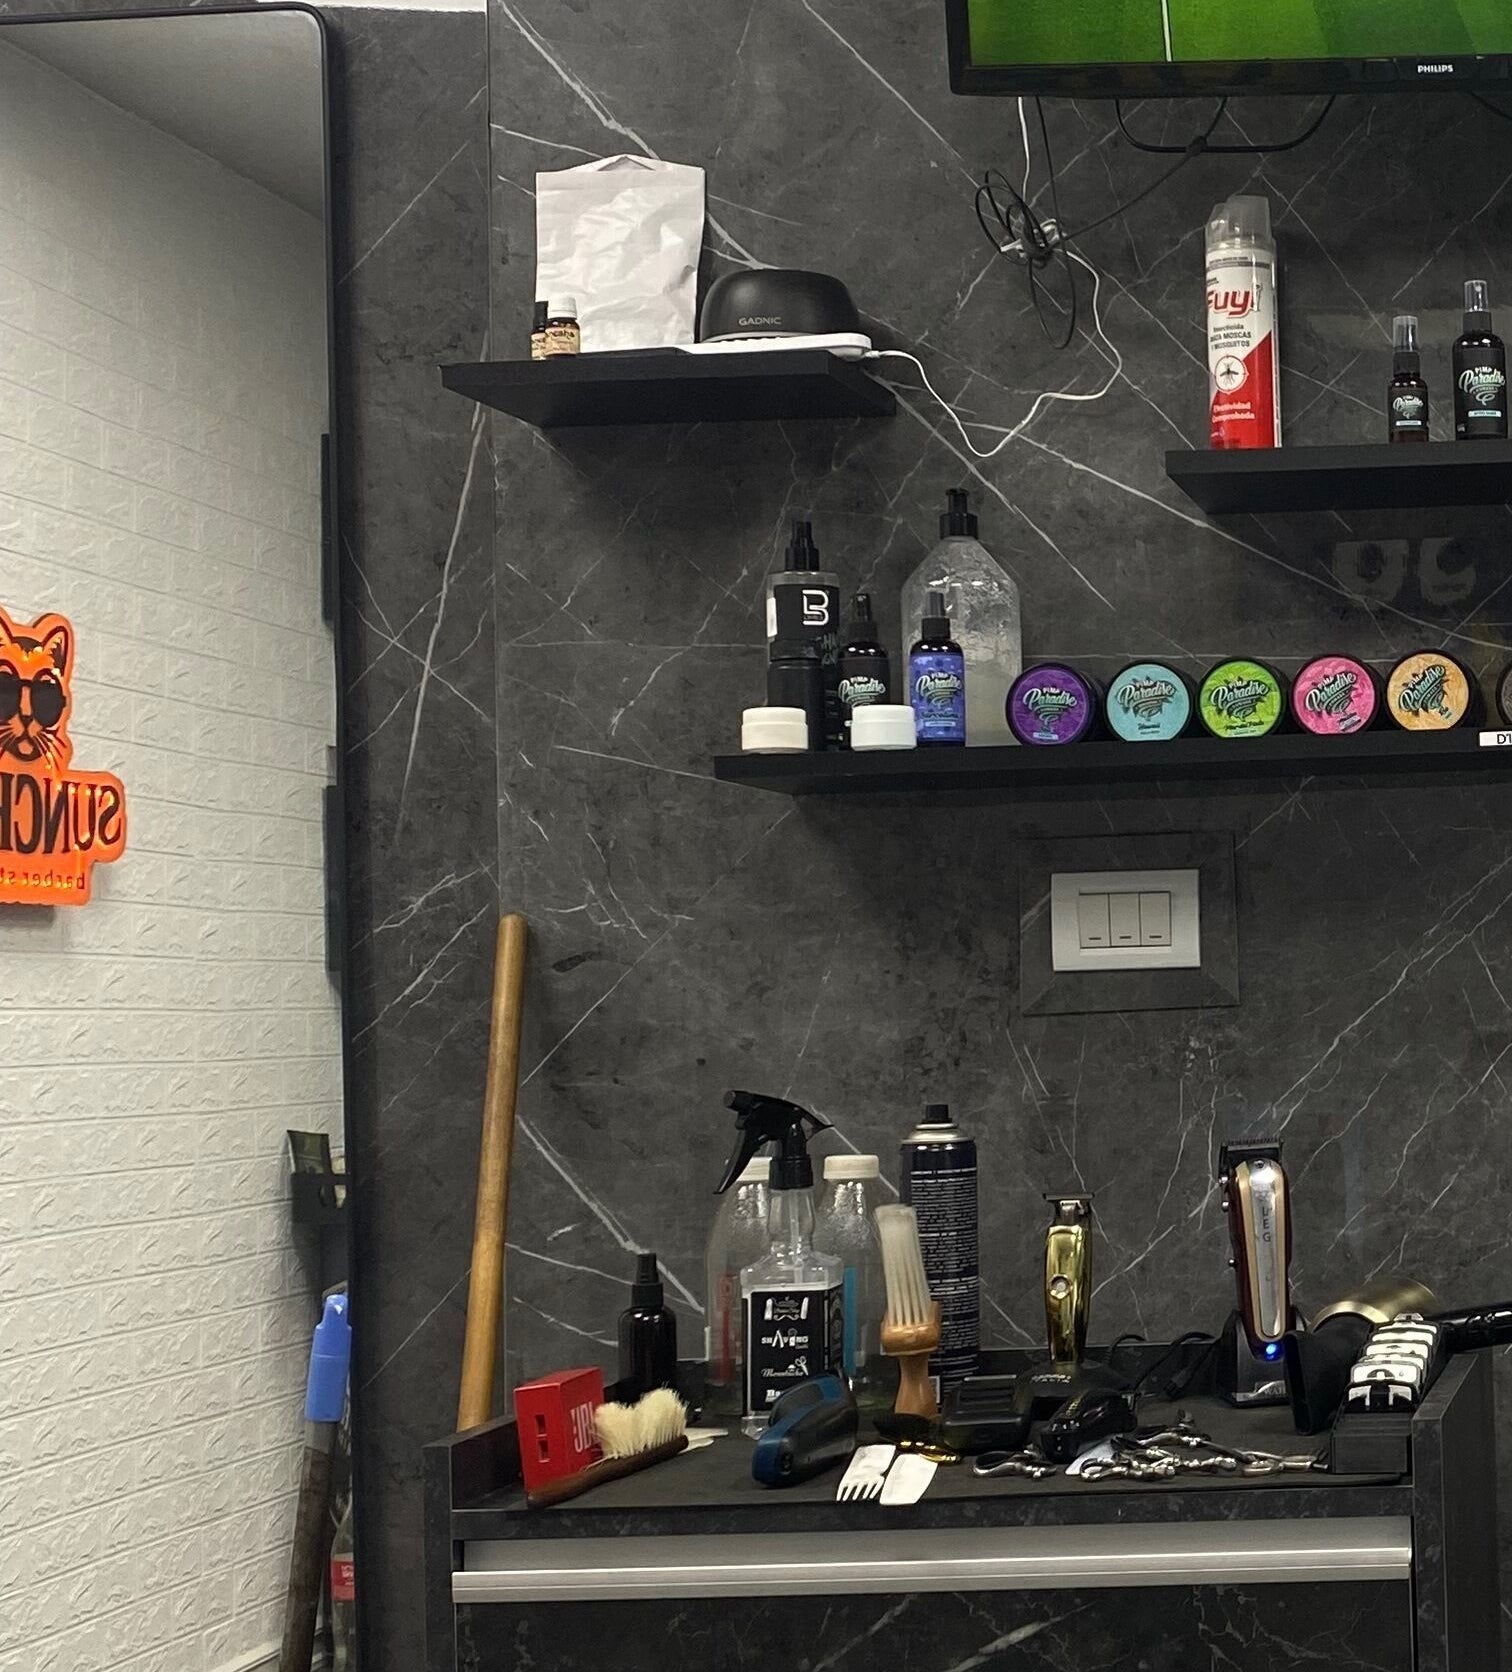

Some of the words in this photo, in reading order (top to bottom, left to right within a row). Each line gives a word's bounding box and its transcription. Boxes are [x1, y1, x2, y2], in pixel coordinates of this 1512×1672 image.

[1417, 64, 1454, 73] PHILIPS
[738, 316, 782, 326] GADNIC
[1214, 340, 1250, 350] MOSQUITOS
[1223, 331, 1251, 339] MOSCAS
[1458, 368, 1506, 393] Paradise
[838, 678, 886, 703] Paradise
[1023, 687, 1078, 710] Paradise
[1117, 681, 1176, 708] Paradise
[1210, 680, 1269, 710] Paradise
[1305, 672, 1357, 711] Paradise
[1400, 666, 1445, 711] Paradise
